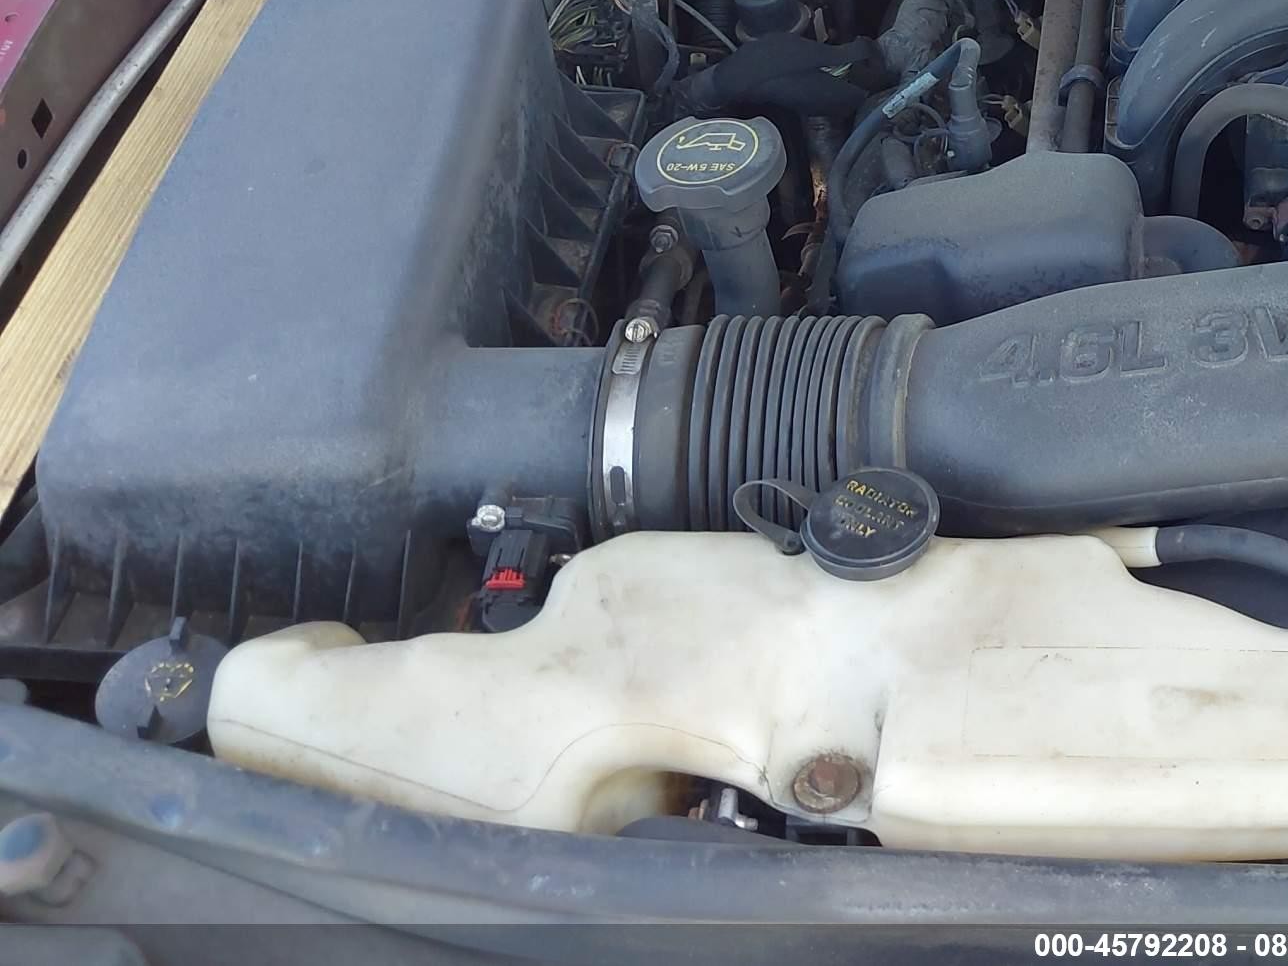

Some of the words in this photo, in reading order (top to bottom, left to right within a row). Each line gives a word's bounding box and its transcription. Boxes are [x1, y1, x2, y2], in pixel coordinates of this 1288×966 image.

[666, 162, 708, 171] 5W-20
[708, 162, 736, 171] SAE
[979, 321, 1167, 384] 4.6L
[846, 480, 918, 518] RADIATOR
